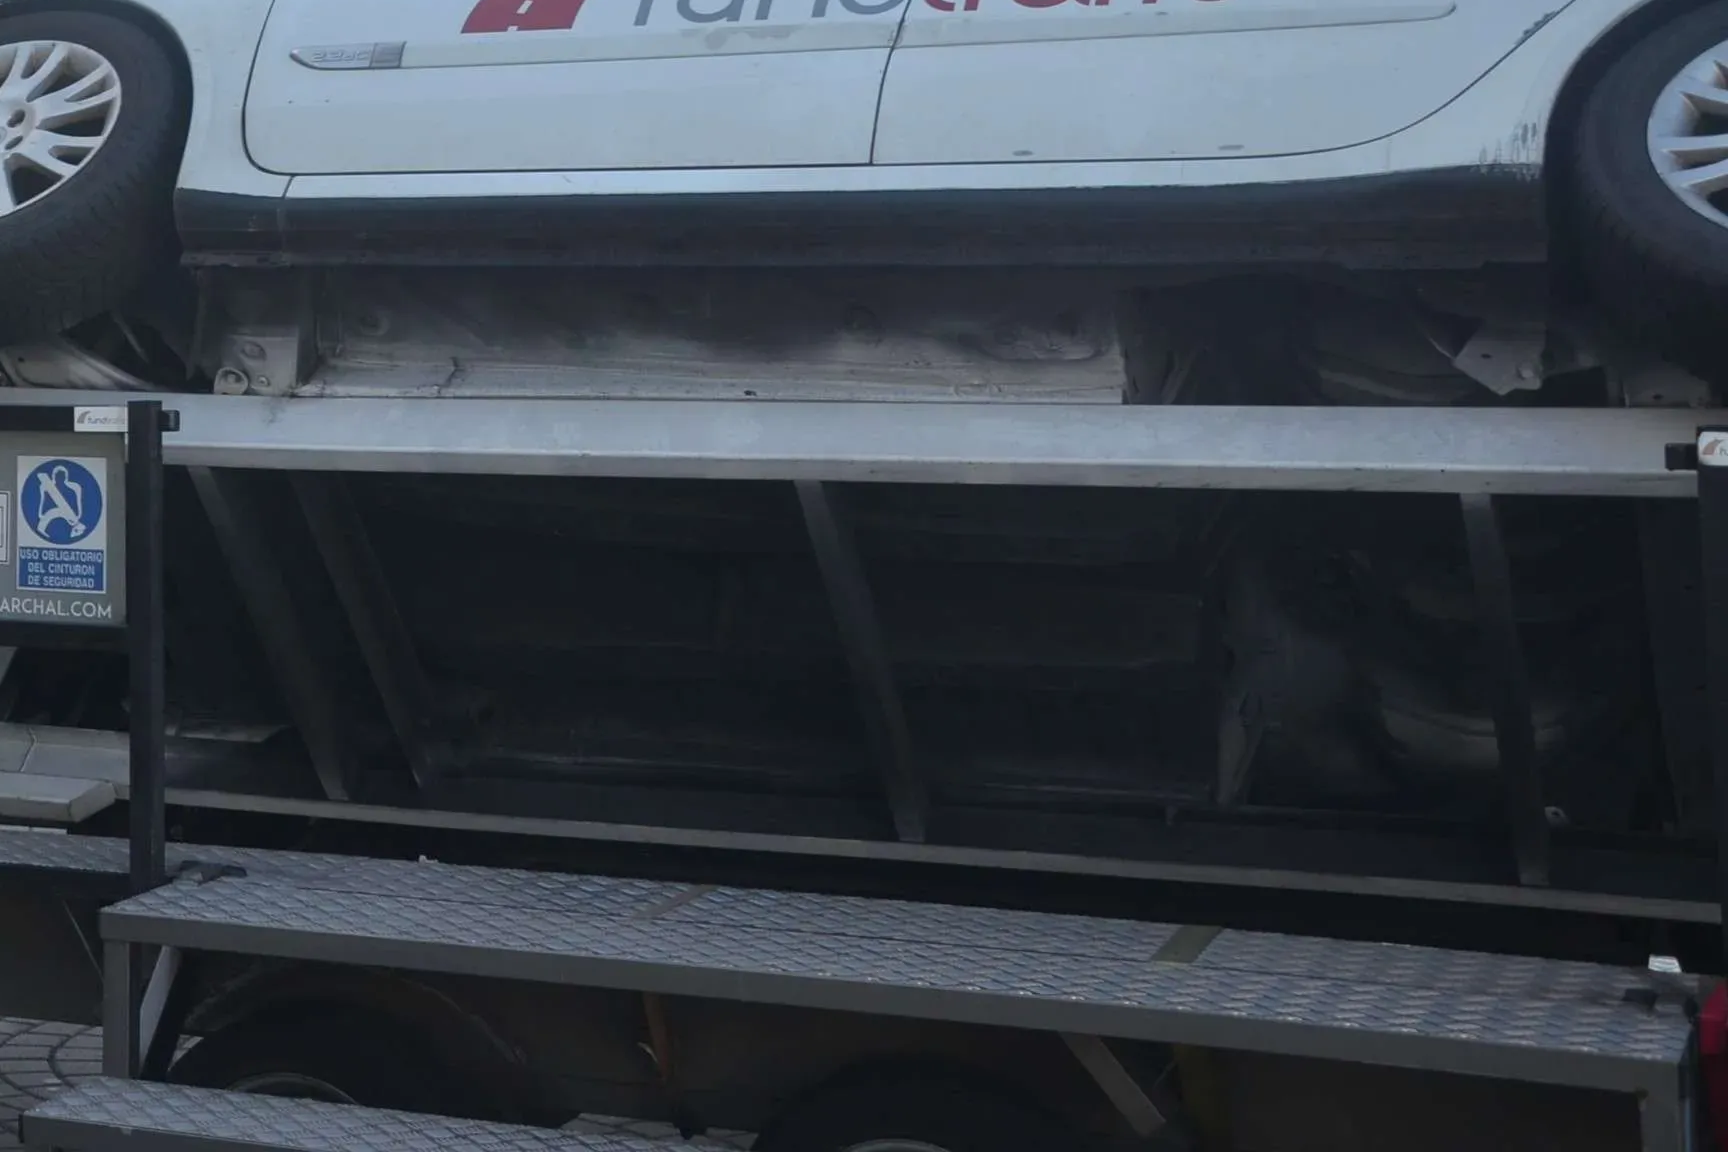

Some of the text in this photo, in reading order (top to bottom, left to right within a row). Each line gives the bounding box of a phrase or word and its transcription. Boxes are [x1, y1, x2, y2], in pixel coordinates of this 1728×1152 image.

[20, 548, 103, 563] USO OBLIGATORIO
[28, 562, 45, 573] DEL
[28, 575, 94, 588] DE SEGURIDAD
